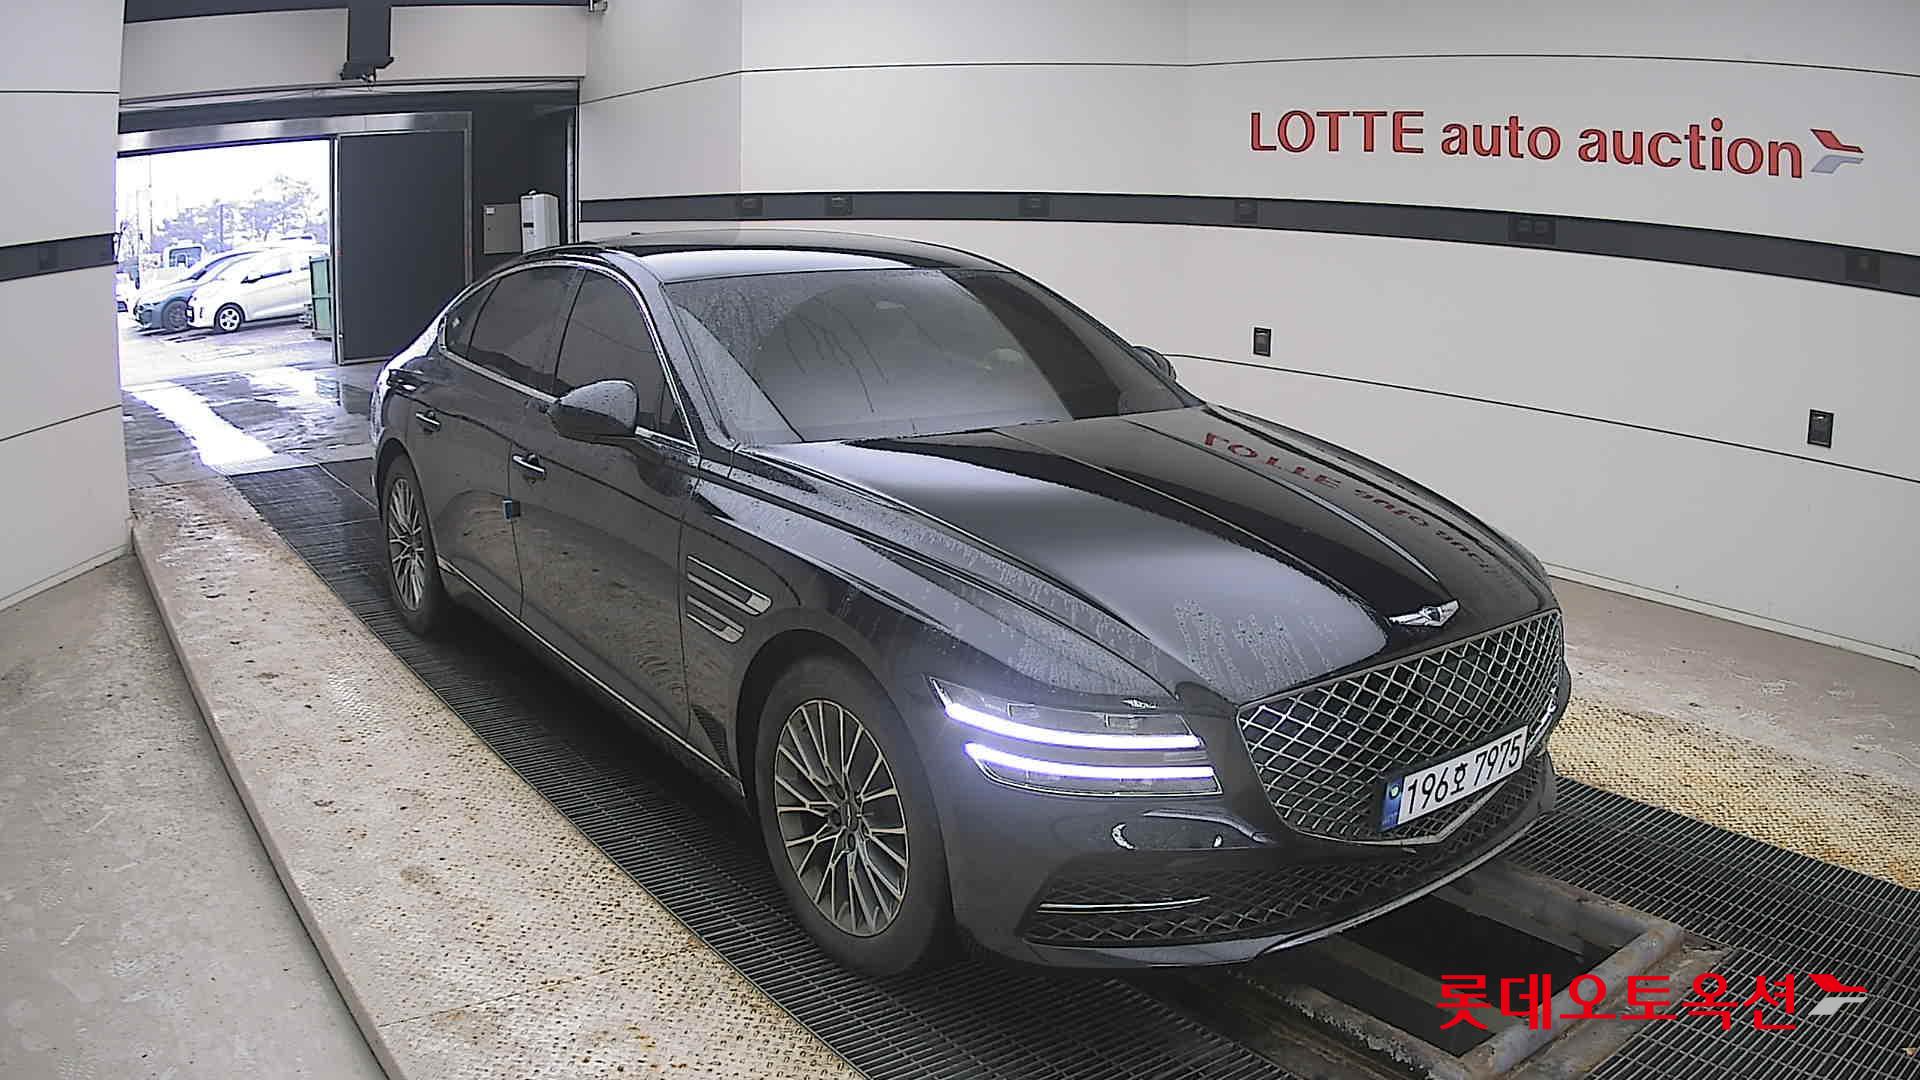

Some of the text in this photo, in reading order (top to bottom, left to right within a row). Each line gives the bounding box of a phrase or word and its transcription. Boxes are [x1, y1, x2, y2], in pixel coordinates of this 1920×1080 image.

[1250, 110, 1803, 179] LOTTE auto auction
[1407, 733, 1523, 815] 196호 7975
